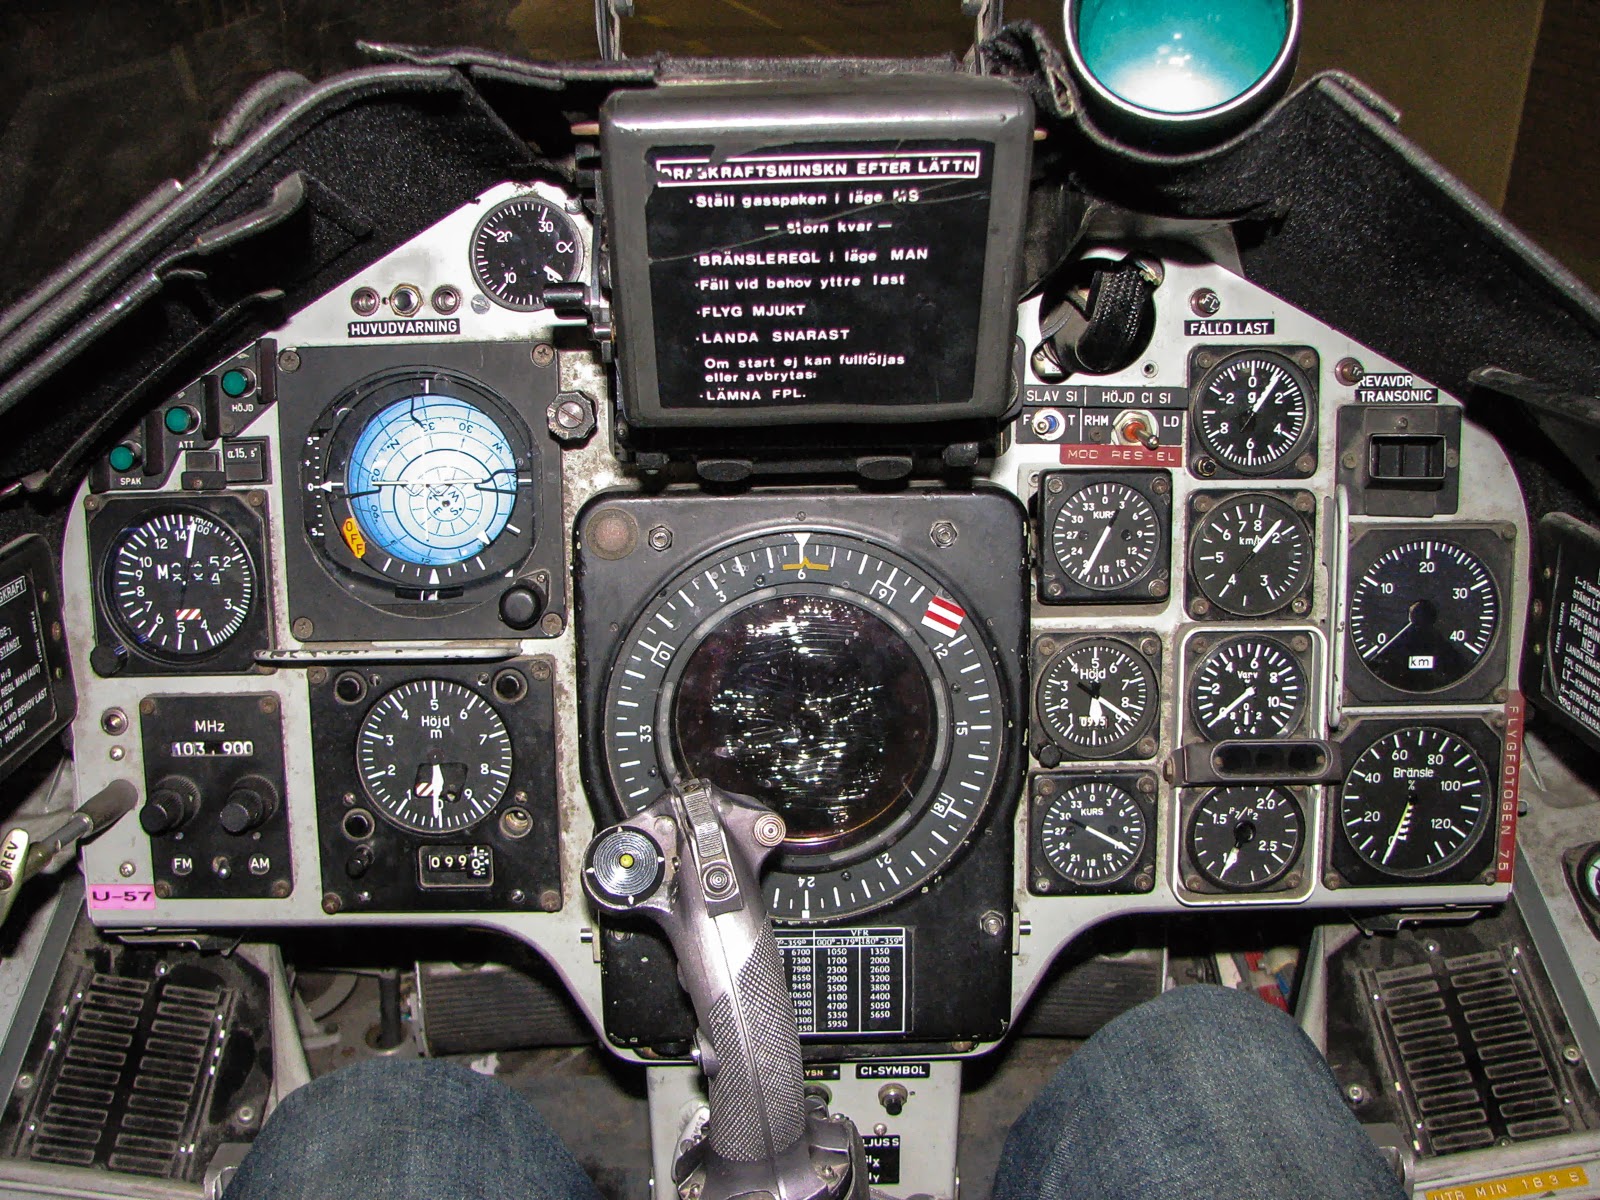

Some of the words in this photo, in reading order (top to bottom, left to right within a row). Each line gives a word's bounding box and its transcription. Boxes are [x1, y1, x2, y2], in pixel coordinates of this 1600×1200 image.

[857, 162, 911, 174] EFTER
[918, 157, 975, 173] LÄTTN
[696, 193, 735, 208] Ställ
[742, 194, 827, 208] gasspaken
[849, 190, 883, 205] läge
[538, 221, 554, 232] 30
[837, 221, 873, 233] kvar
[496, 231, 512, 243] 20
[699, 251, 821, 267] BRÄNSLEREGL
[845, 249, 877, 264] läge
[890, 249, 928, 261] MAN
[503, 272, 517, 284] 10
[700, 278, 729, 291] Fäll
[735, 278, 759, 290] vid
[766, 277, 812, 289] behov
[820, 276, 861, 290] yttre
[873, 274, 905, 286] last
[701, 305, 743, 318] FLYG
[752, 304, 806, 317] MJUKT
[351, 321, 458, 335] HUVUDVARNING
[1190, 321, 1232, 335] FÄLLD
[1236, 322, 1268, 334] LAST
[702, 332, 759, 344] LANDA
[772, 329, 850, 342] SNARAST
[704, 358, 730, 369] Om
[738, 357, 775, 369] start
[783, 357, 798, 369] ej
[804, 356, 831, 366] kan
[839, 352, 905, 367] fullföljas
[704, 372, 739, 383] eller
[1248, 376, 1257, 388] 0
[706, 387, 761, 401] LÄMNA
[772, 389, 806, 400] FPL.
[1026, 391, 1059, 401] SLAV
[1066, 391, 1077, 401] SI
[1102, 390, 1135, 403] HÖJD
[1141, 392, 1152, 404] CI
[1159, 393, 1171, 404] SI
[1218, 393, 1235, 405] -2
[1274, 392, 1283, 404] 2
[1360, 390, 1432, 402] TRANSONIC
[232, 402, 254, 412] HÖJD
[1023, 414, 1031, 426] F
[1068, 414, 1076, 425] T
[1084, 415, 1109, 426] RHM
[1163, 416, 1180, 428] LD
[1220, 422, 1229, 434] 8
[1273, 423, 1281, 434] 4
[178, 440, 194, 449] ATT
[1246, 438, 1255, 450] 6
[120, 477, 142, 485] SPAK
[175, 530, 187, 541] 14
[346, 521, 363, 554] OFF
[155, 537, 168, 549] 12
[139, 556, 152, 568] 10
[222, 556, 231, 568] 2
[1419, 562, 1435, 573] 20
[135, 570, 143, 581] 9
[157, 564, 168, 580] M
[798, 569, 806, 580] 6
[136, 586, 145, 597] 8
[878, 589, 888, 599] 9
[1380, 583, 1394, 594] 10
[1452, 588, 1468, 599] 30
[716, 591, 727, 603] 3
[145, 601, 153, 613] 7
[224, 598, 232, 610] 3
[156, 613, 164, 624] 6
[200, 619, 208, 630] 4
[177, 621, 186, 633] 5
[1377, 632, 1386, 644] 0
[1450, 630, 1465, 642] 40
[933, 642, 948, 660] 12
[1080, 668, 1106, 682] Höjd
[430, 700, 439, 710] 5
[1267, 696, 1280, 708] 10
[402, 709, 409, 721] 4
[460, 708, 468, 720] 6
[194, 720, 225, 733] MHz
[422, 715, 450, 729] Höjd
[956, 720, 968, 736] 15
[430, 729, 443, 739] m
[479, 734, 488, 745] 7
[640, 724, 652, 743] 33
[386, 735, 394, 746] 3
[1391, 750, 1408, 761] 60
[1428, 754, 1444, 765] 80
[387, 764, 396, 776] 2
[481, 763, 489, 775] 8
[1393, 767, 1434, 779] Bränsle
[1500, 705, 1519, 835] FLYGFOTOGEN
[1364, 772, 1381, 784] 40
[1441, 781, 1461, 791] 100
[406, 789, 412, 800] 1
[464, 788, 473, 799] 9
[933, 796, 949, 812] 18
[1256, 798, 1275, 810] 2.0
[1081, 808, 1104, 816] KURS
[1363, 811, 1380, 822] 20
[1213, 813, 1228, 825] 1.5
[1431, 819, 1451, 829] 120
[1258, 840, 1278, 852] 2.5
[1, 841, 19, 869] REV
[875, 852, 893, 868] 21
[1498, 849, 1510, 871] 75
[174, 858, 192, 869] FM
[250, 858, 270, 868] AM
[798, 876, 816, 888] 24
[92, 891, 152, 901] U-57
[860, 1065, 926, 1076] CI-SYMBOL
[1475, 1183, 1507, 1197] MIN
